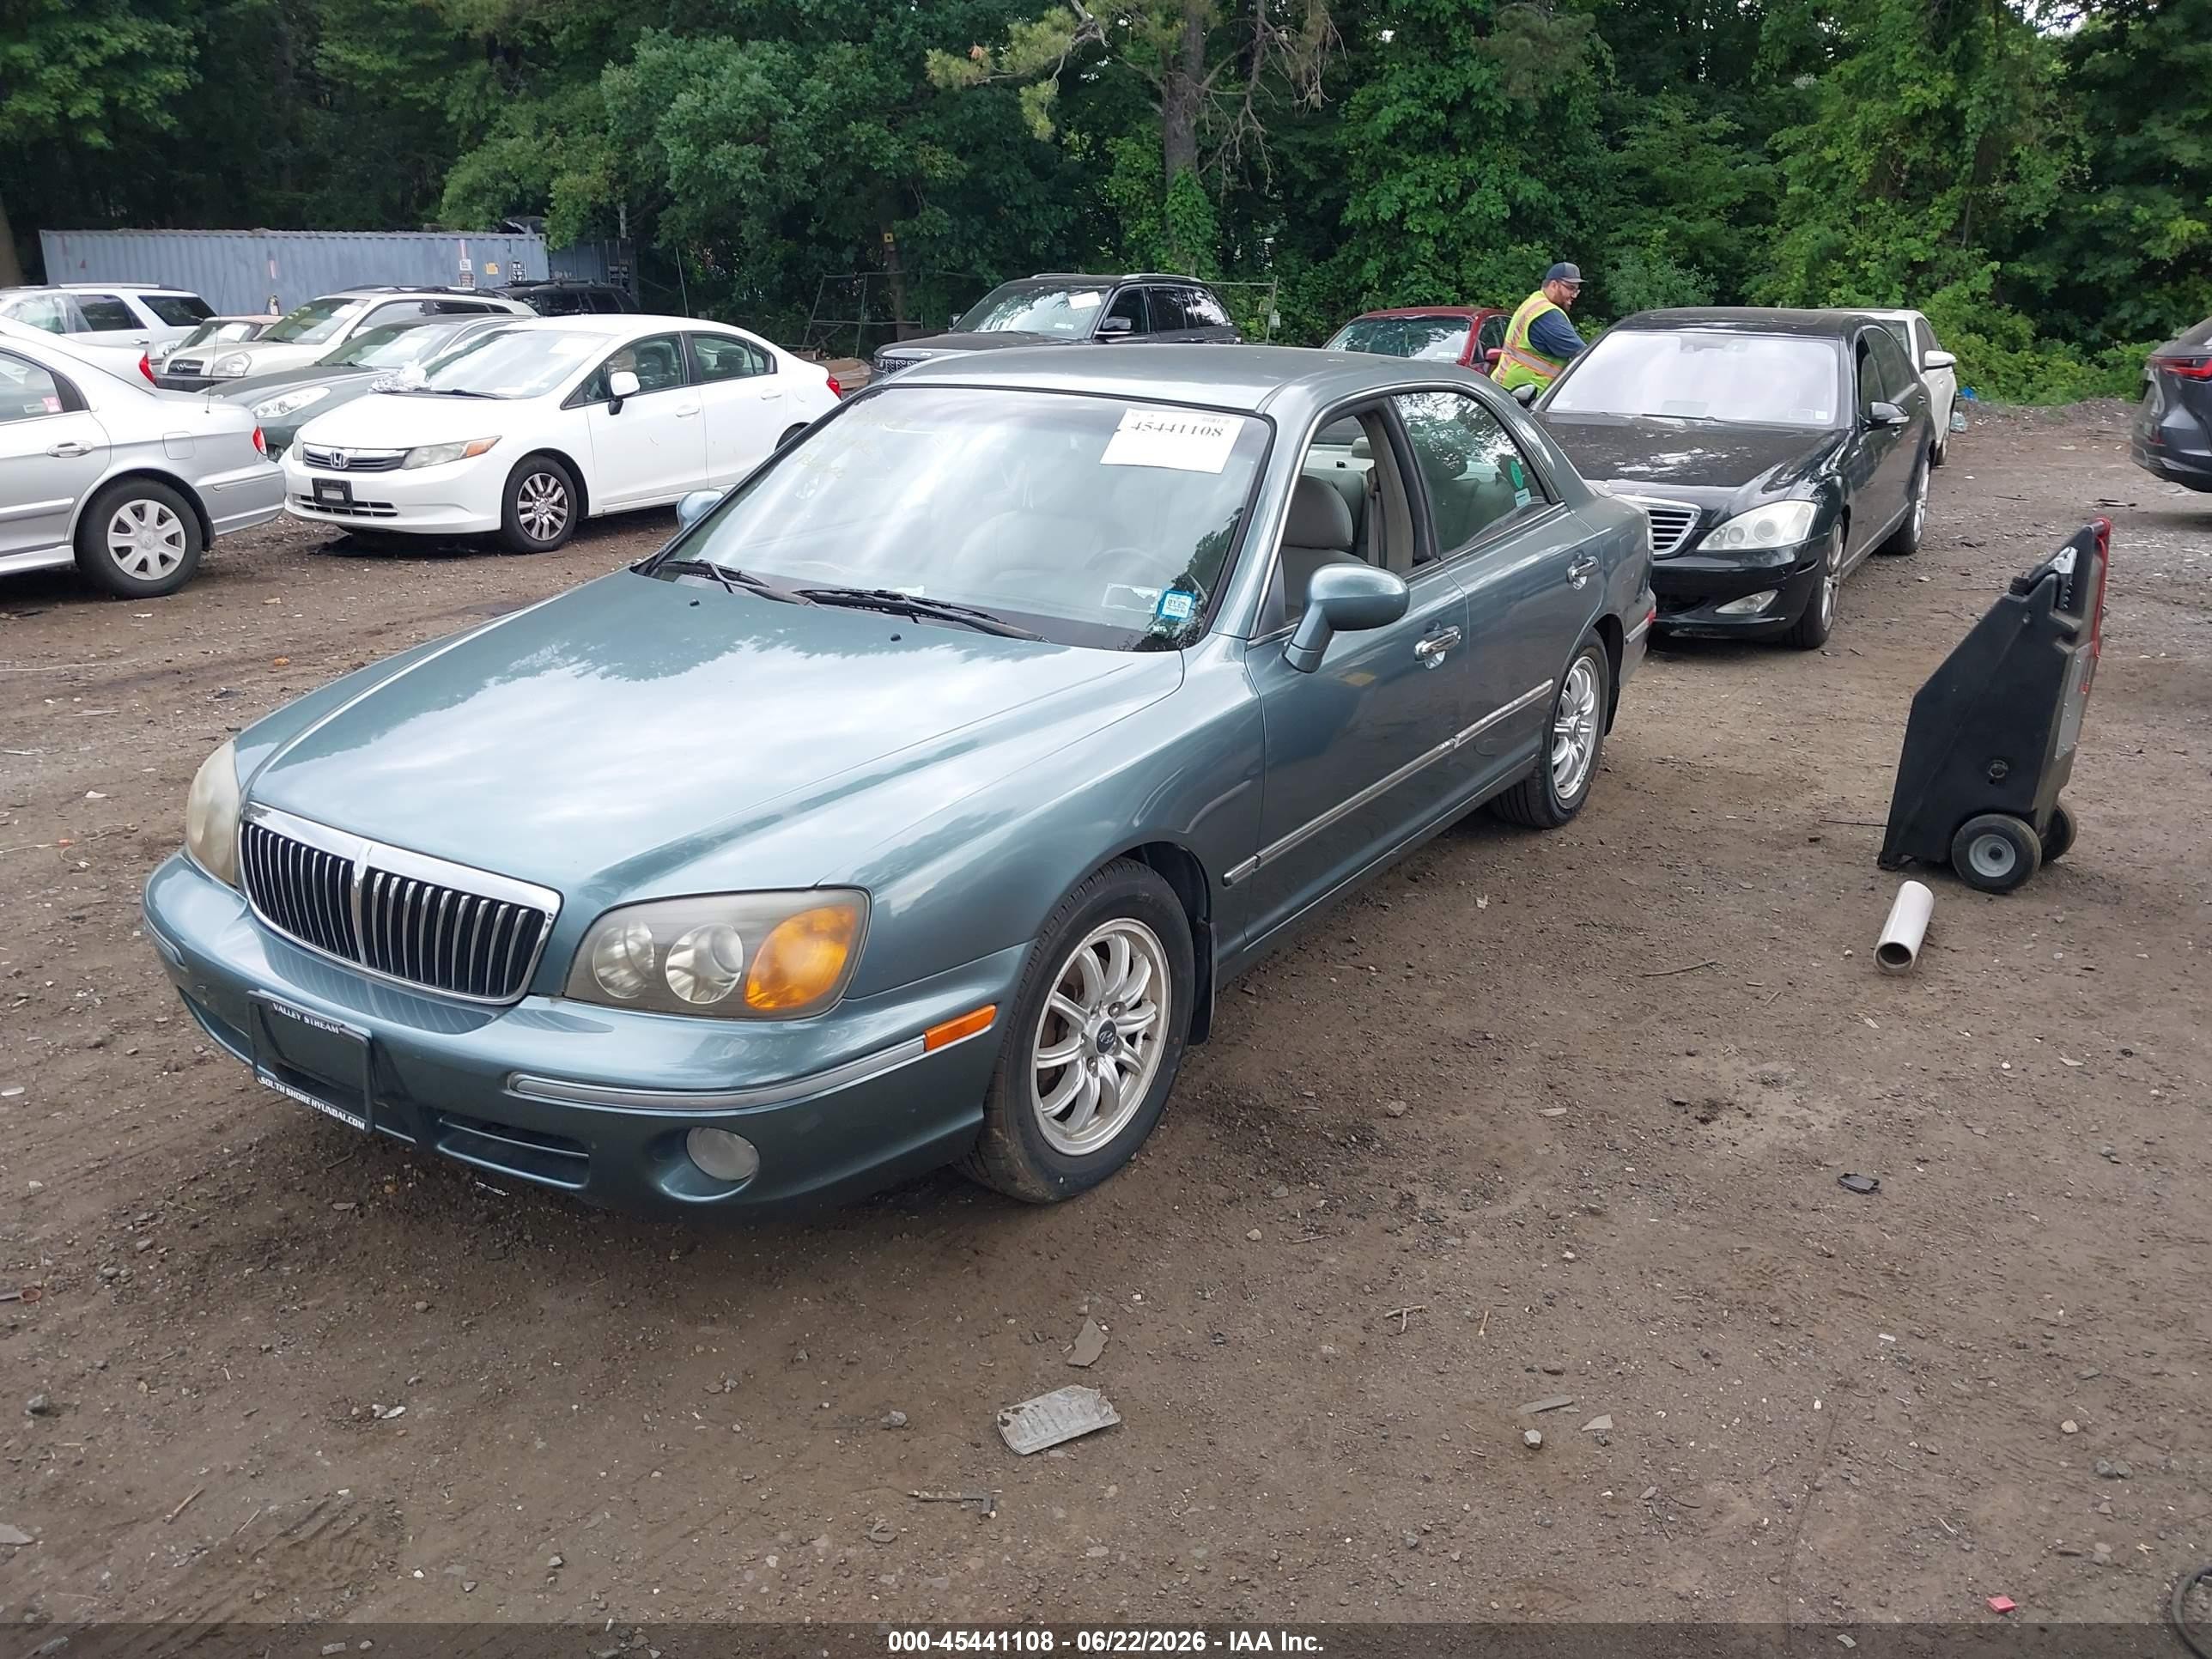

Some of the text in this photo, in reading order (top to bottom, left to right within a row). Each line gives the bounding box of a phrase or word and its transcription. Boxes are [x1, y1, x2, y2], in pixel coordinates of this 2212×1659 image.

[1131, 421, 1224, 436] 45441108
[272, 1002, 339, 1034] VALLEY STREAM
[260, 1076, 365, 1131] SOUTH SHORE HYUNDAI.COM
